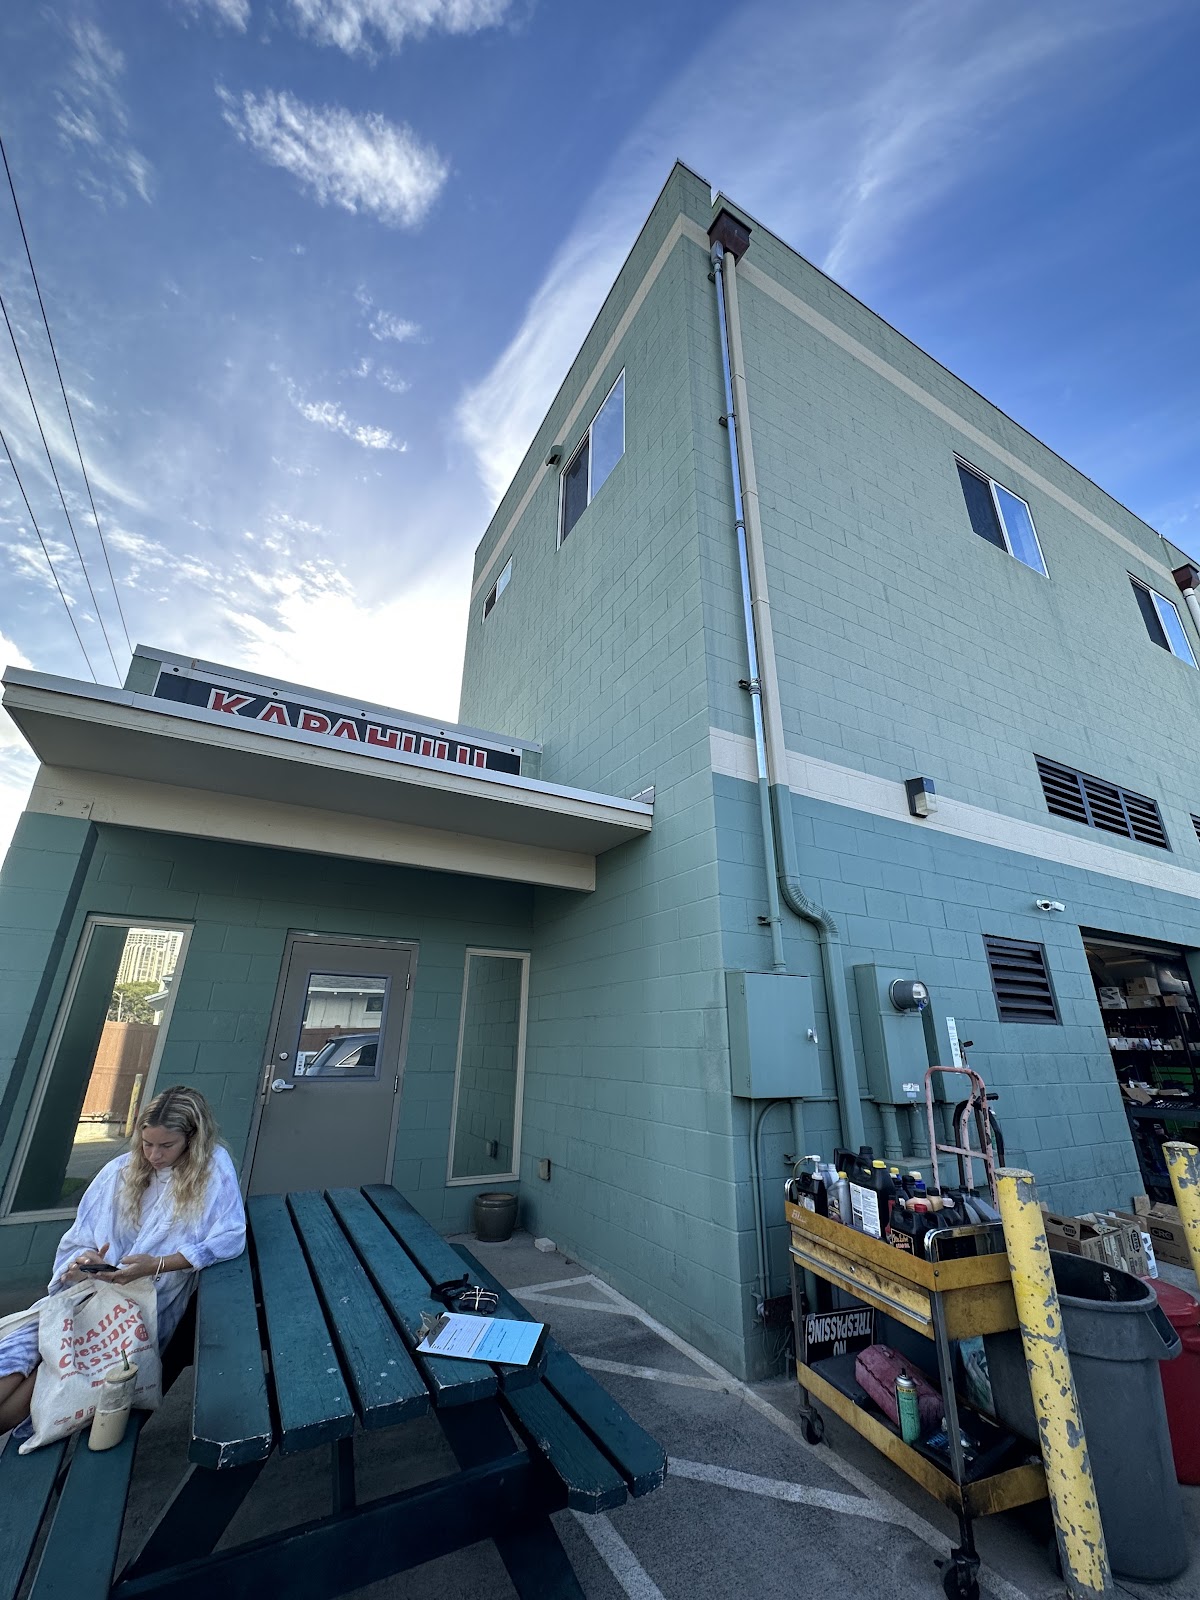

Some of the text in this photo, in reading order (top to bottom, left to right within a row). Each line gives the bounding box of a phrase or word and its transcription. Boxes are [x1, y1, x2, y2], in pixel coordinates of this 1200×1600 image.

[62, 1298, 139, 1346] HWAIIAN
[808, 1311, 871, 1345] TRESPASSING
[59, 1336, 133, 1370] CASSIC
[833, 1340, 847, 1356] NO
